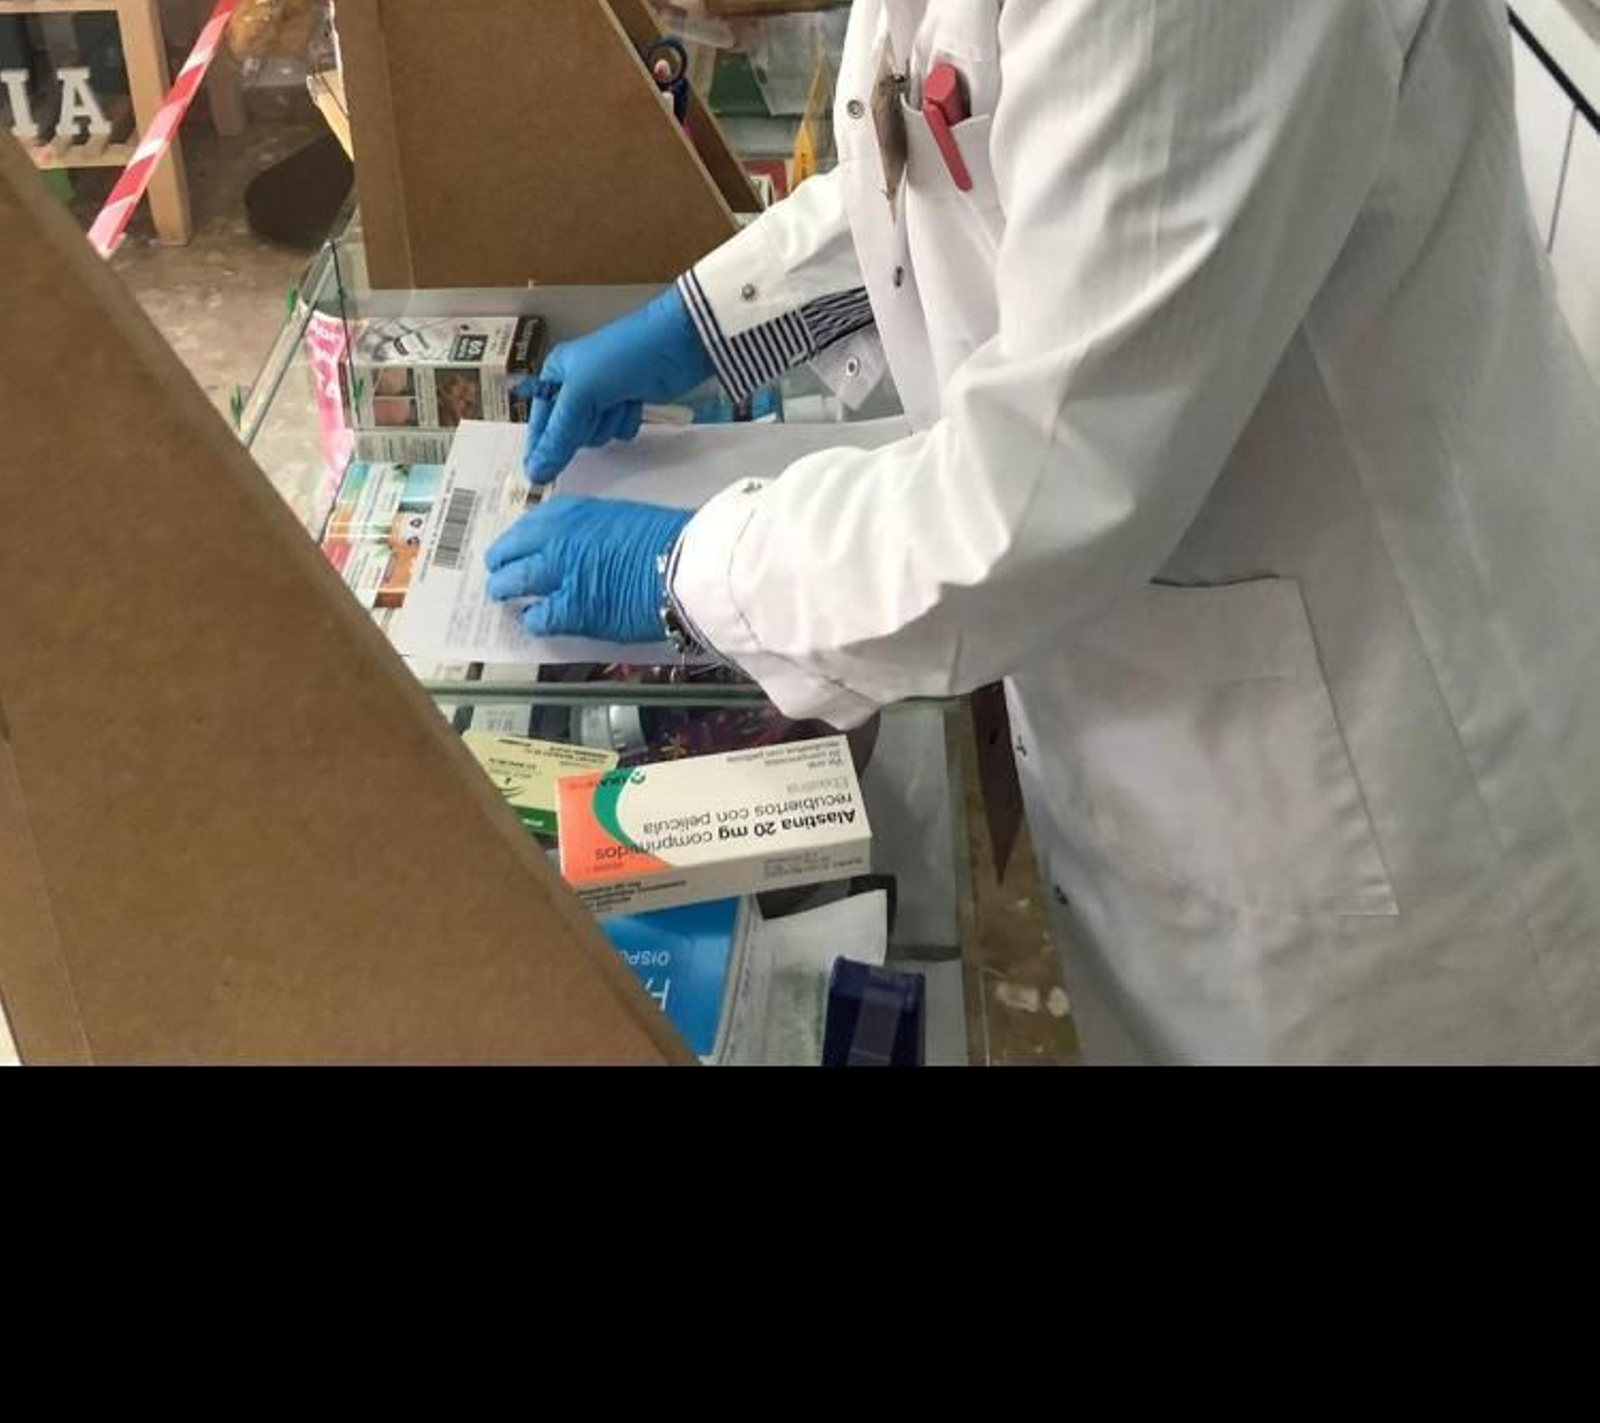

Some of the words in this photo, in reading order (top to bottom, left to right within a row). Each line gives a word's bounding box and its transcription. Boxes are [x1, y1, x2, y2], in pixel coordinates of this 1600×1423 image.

[754, 793, 852, 816] recubiertos
[717, 808, 749, 823] con
[781, 809, 855, 832] Alastina
[718, 824, 749, 842] mg
[754, 821, 776, 838] 20
[595, 831, 713, 860] comprimidos
